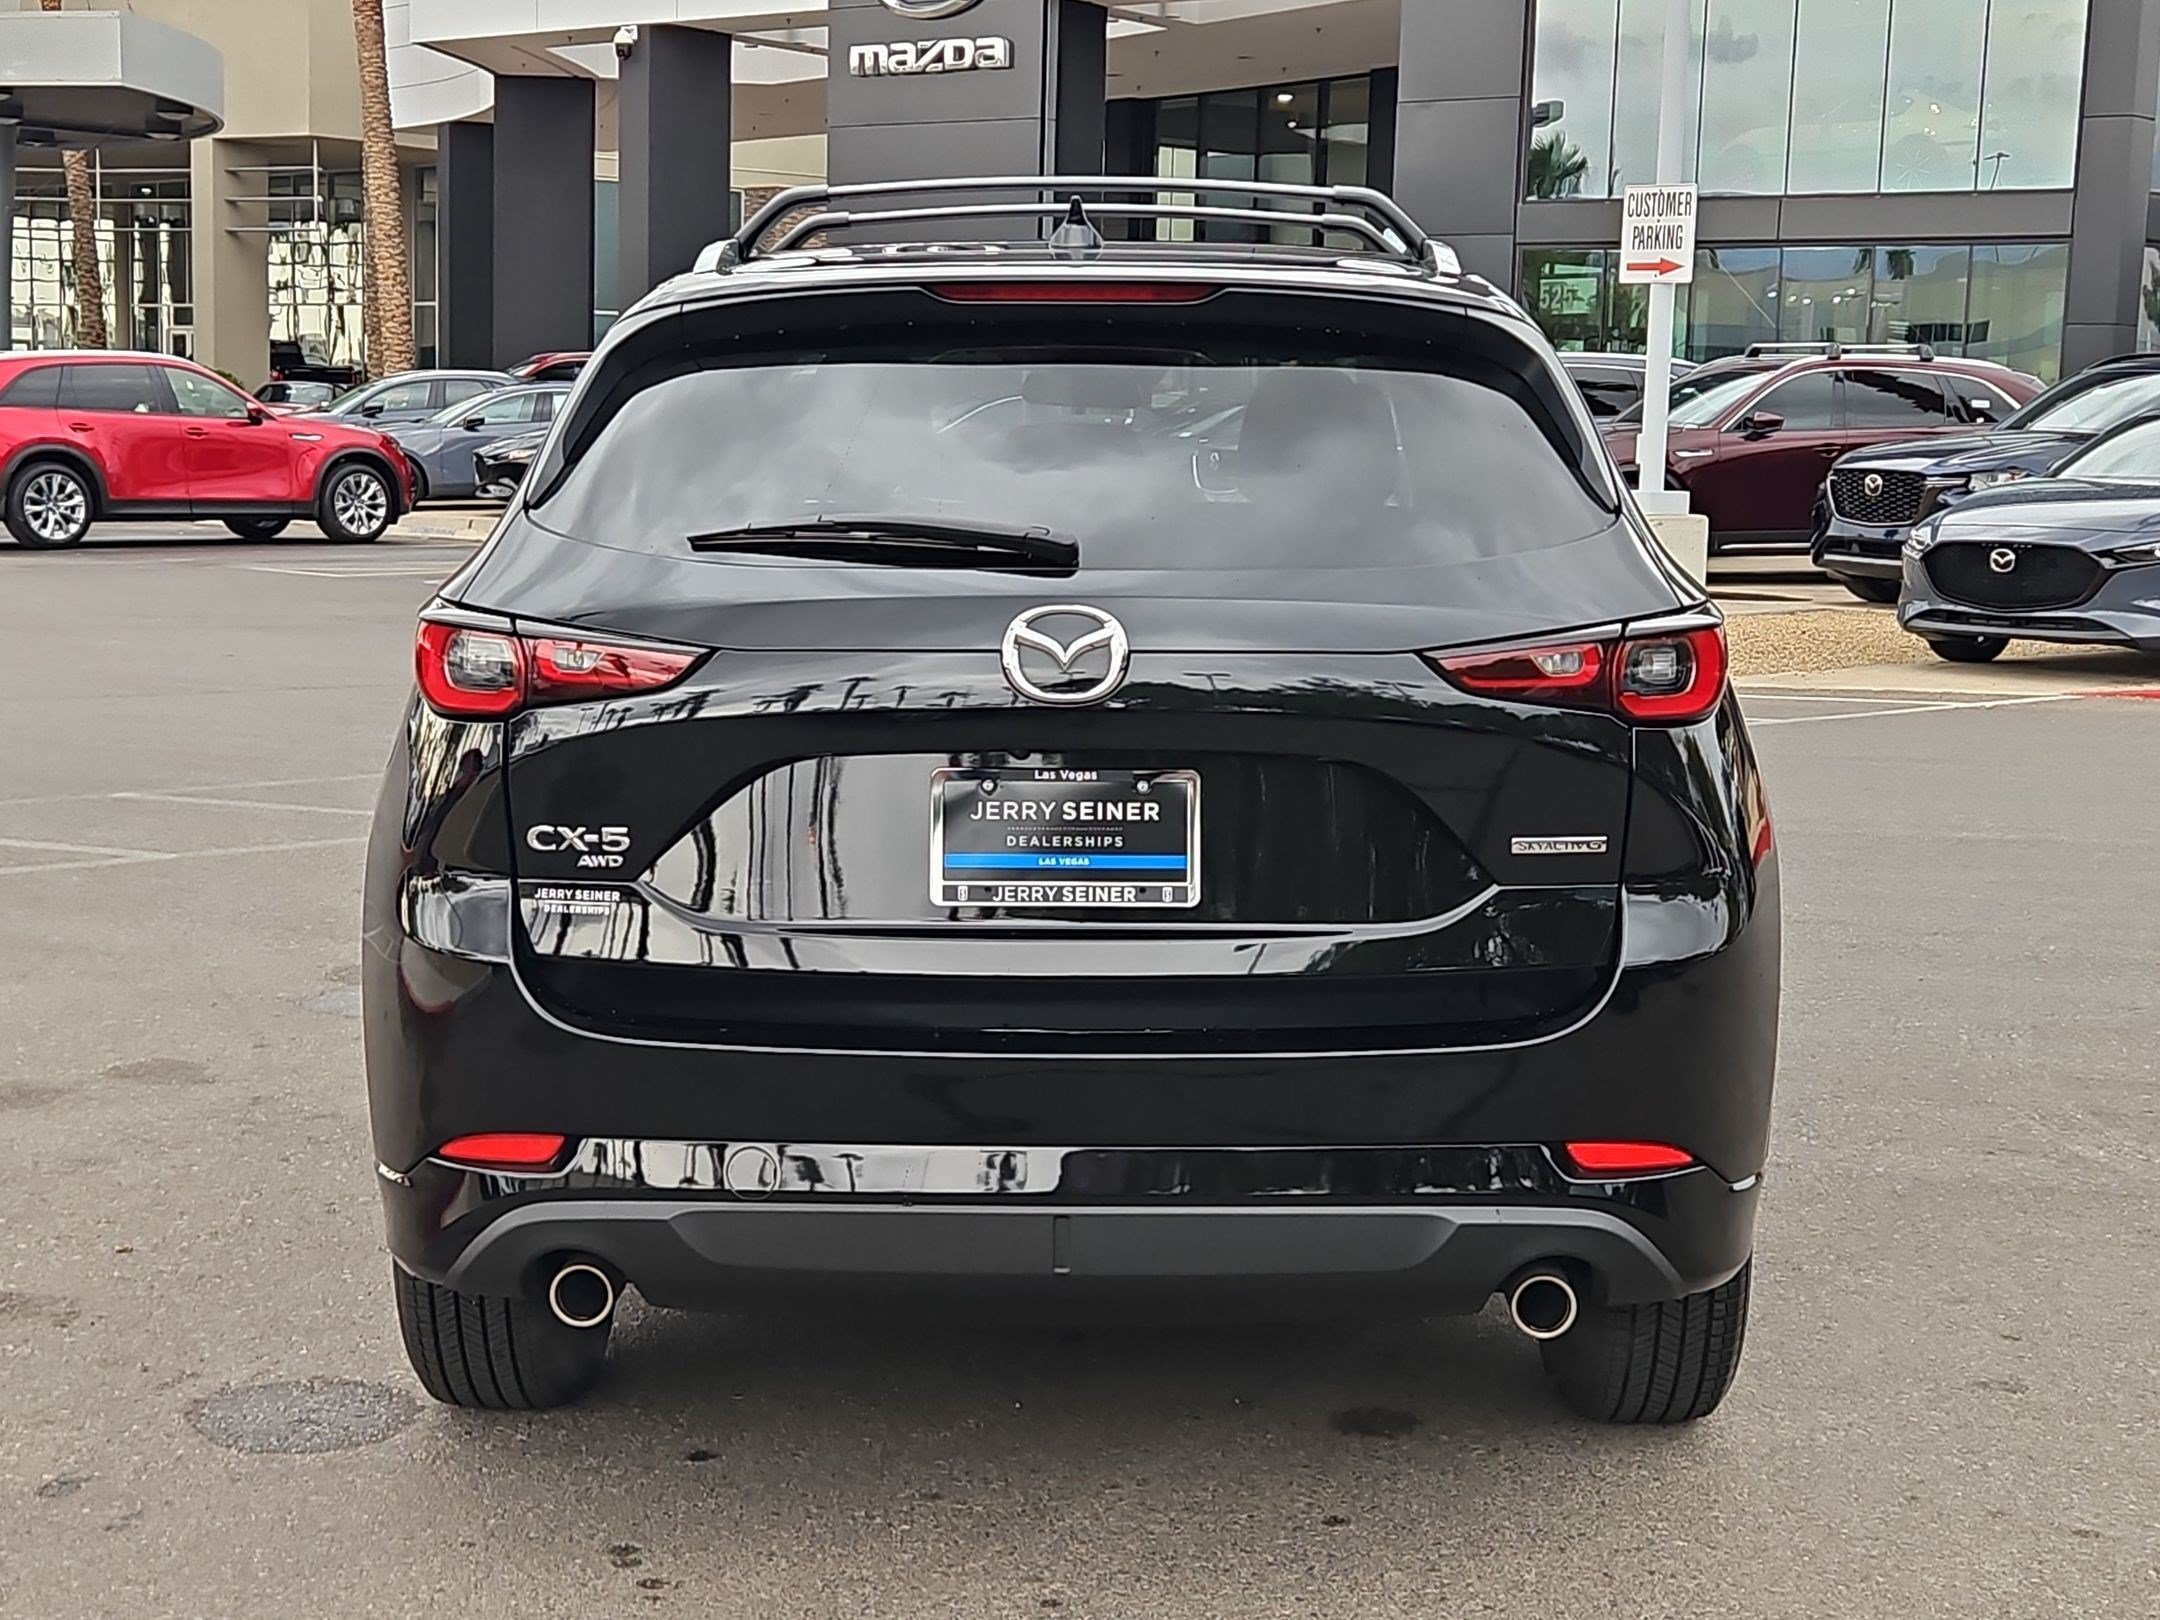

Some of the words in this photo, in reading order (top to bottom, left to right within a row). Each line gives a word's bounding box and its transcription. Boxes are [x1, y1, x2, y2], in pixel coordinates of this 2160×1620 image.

[1627, 191, 1692, 217] CUSTOMER
[1632, 225, 1683, 250] PARKING
[1034, 770, 1056, 780] Las
[1060, 770, 1098, 781] Vegas
[970, 801, 1054, 821] JERRY
[1062, 801, 1160, 821] SEINER
[526, 824, 631, 852] CX-5
[1006, 835, 1124, 848] DEALERSHIPS
[576, 855, 624, 867] AWD
[1038, 857, 1057, 866] LAS
[1059, 857, 1090, 866] VEGAS
[534, 888, 574, 899] JERRY
[575, 890, 620, 901] SEINER
[992, 887, 1057, 902] JERRY
[1062, 887, 1136, 902] SEINER
[543, 905, 610, 915] DEALERSHIPS
